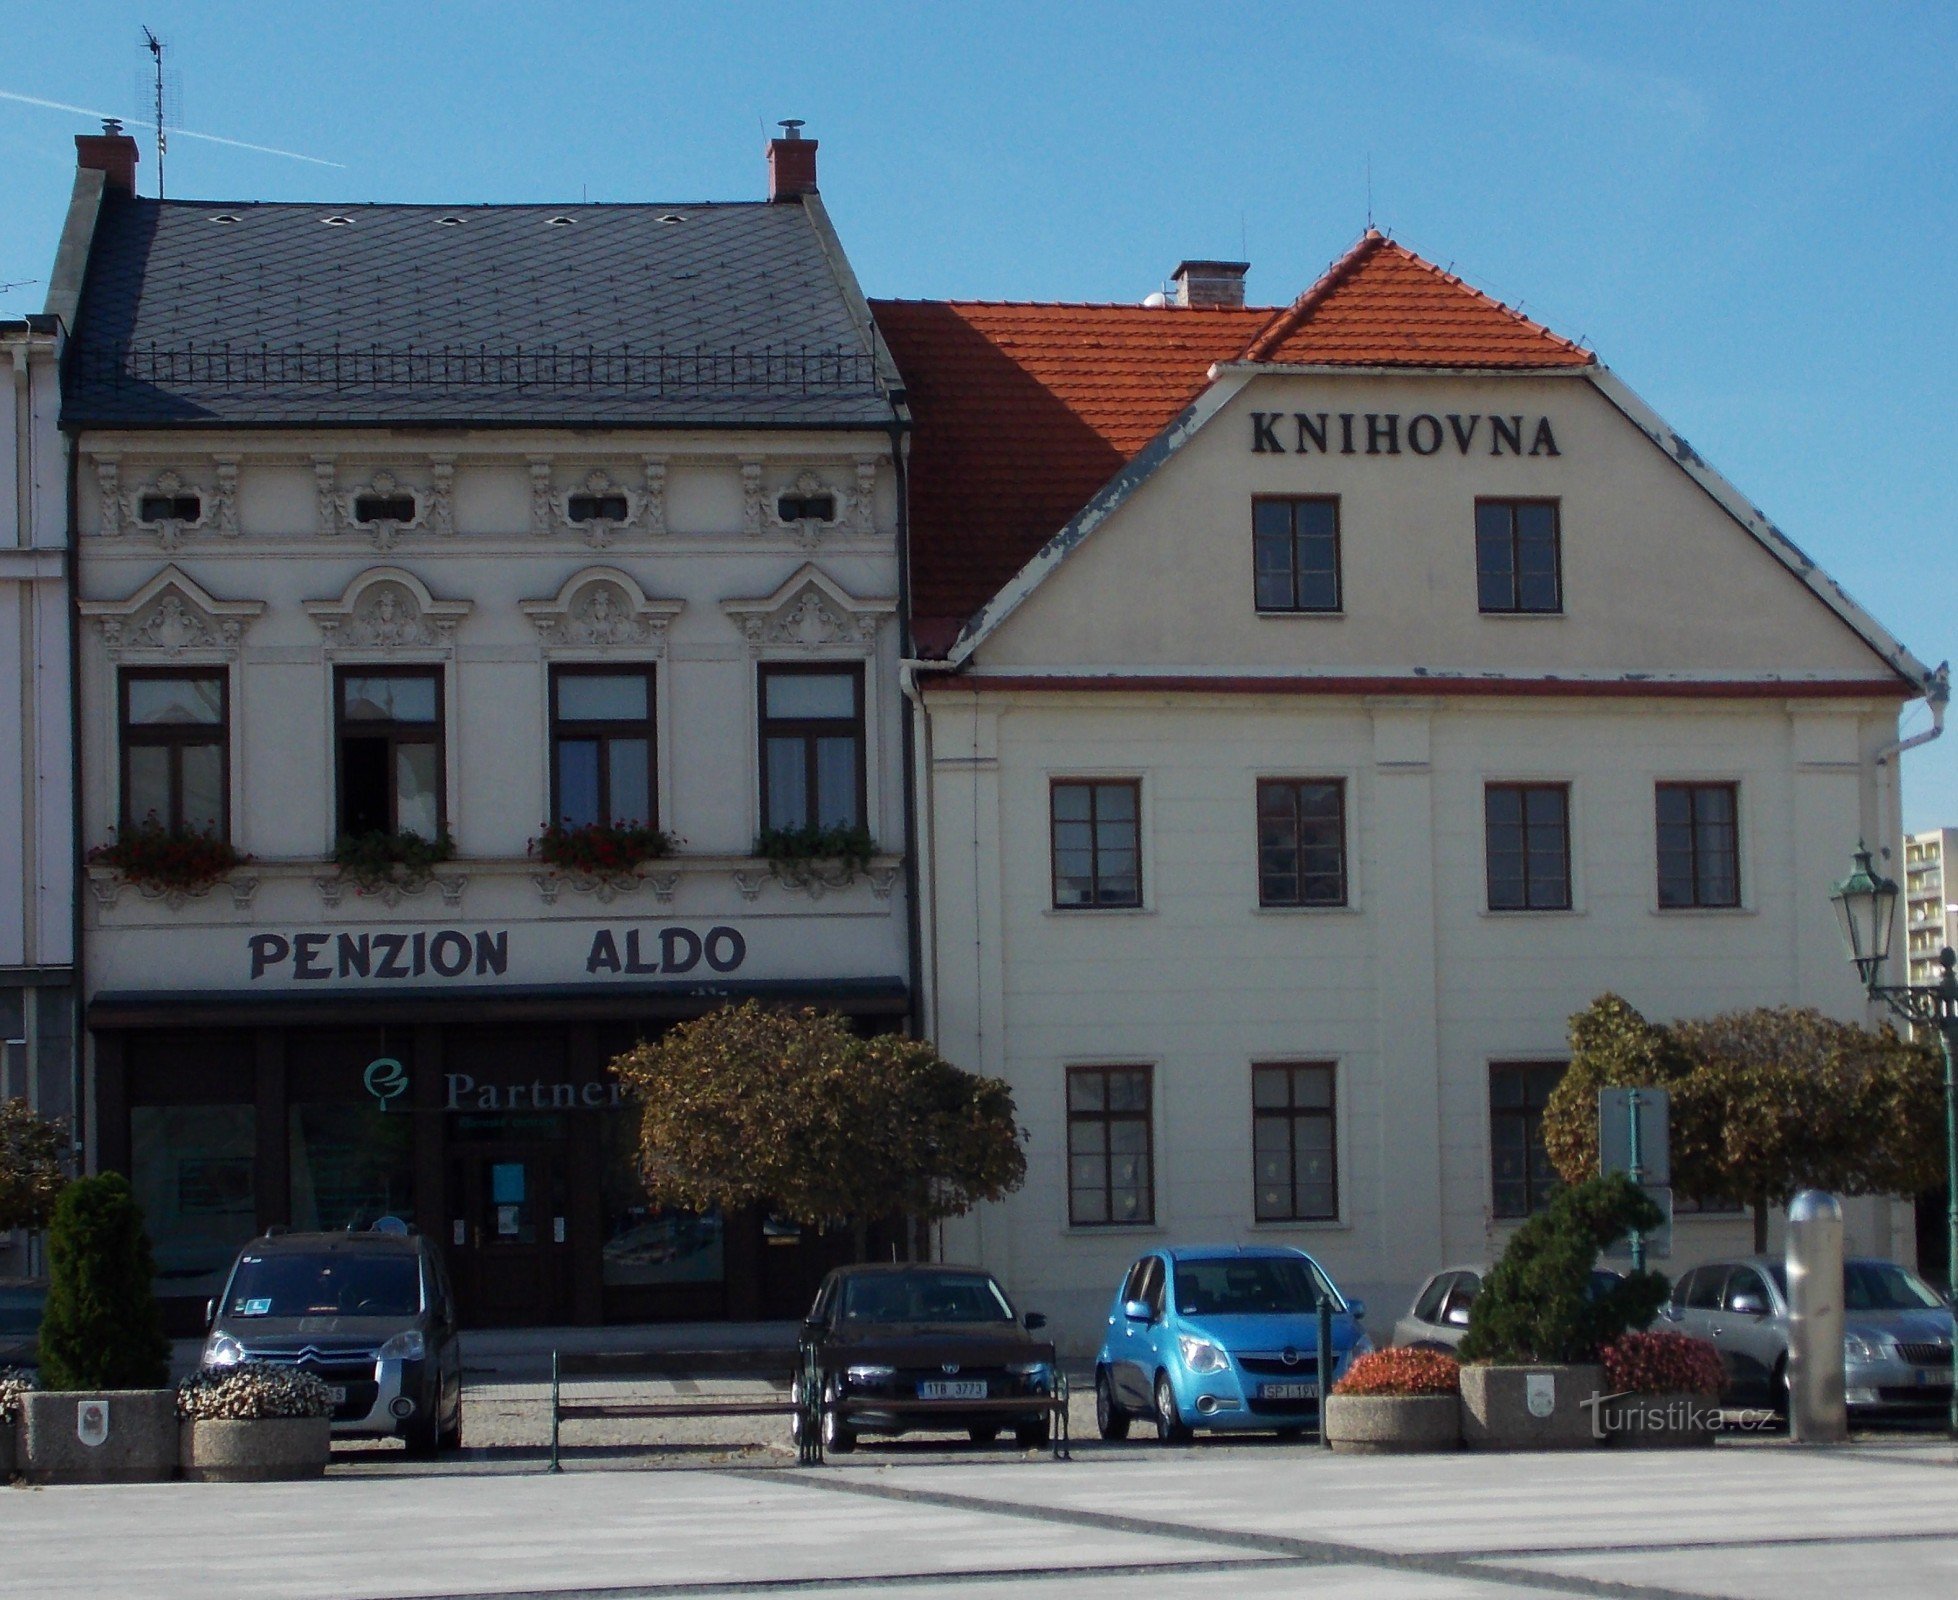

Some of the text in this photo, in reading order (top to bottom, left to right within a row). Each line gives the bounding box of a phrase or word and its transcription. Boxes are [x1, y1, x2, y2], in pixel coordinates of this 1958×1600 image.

[1249, 412, 1562, 456] KNIHOVNA
[248, 926, 747, 980] PENZION ALDO
